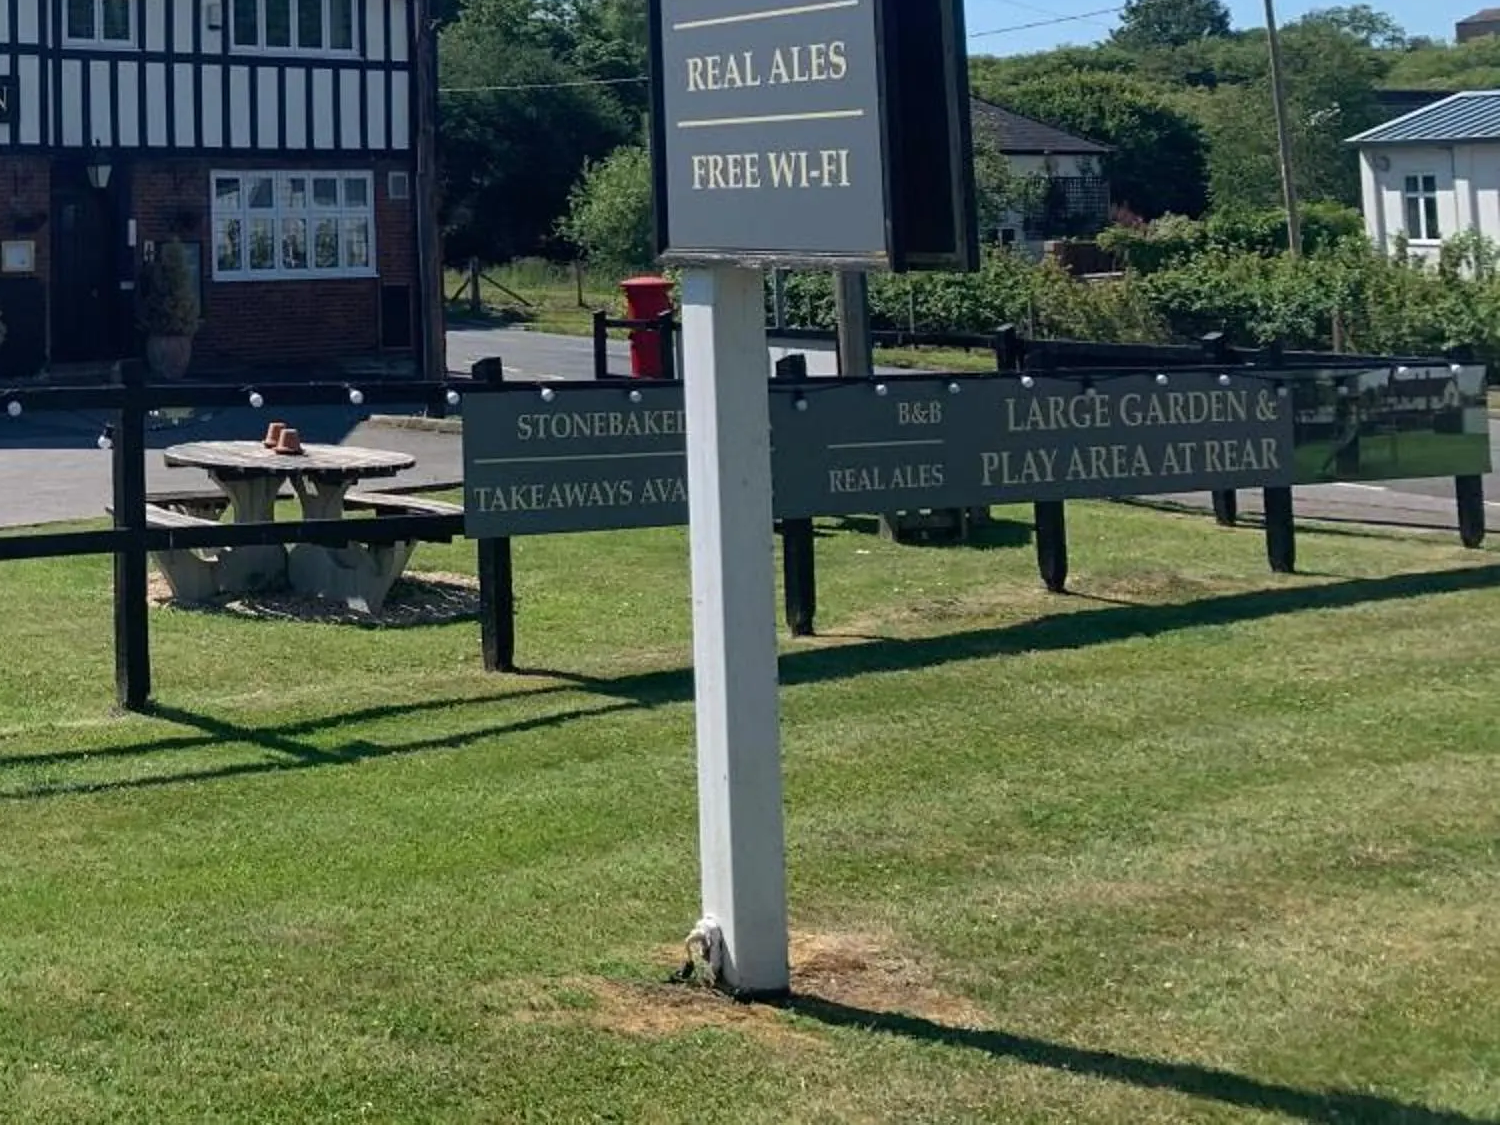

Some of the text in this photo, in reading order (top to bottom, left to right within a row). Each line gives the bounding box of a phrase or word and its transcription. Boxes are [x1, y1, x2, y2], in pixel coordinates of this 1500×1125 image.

[686, 41, 847, 92] REAL ALES
[692, 149, 851, 189] FREE WI-FI
[898, 402, 942, 424] B&B
[1005, 388, 1277, 431] LARGE GARDEN &
[828, 464, 943, 493] REAL ALES
[980, 438, 1280, 486] PLAY AREA AT REAR
[474, 477, 687, 512] TAKEAWAYS AVA
